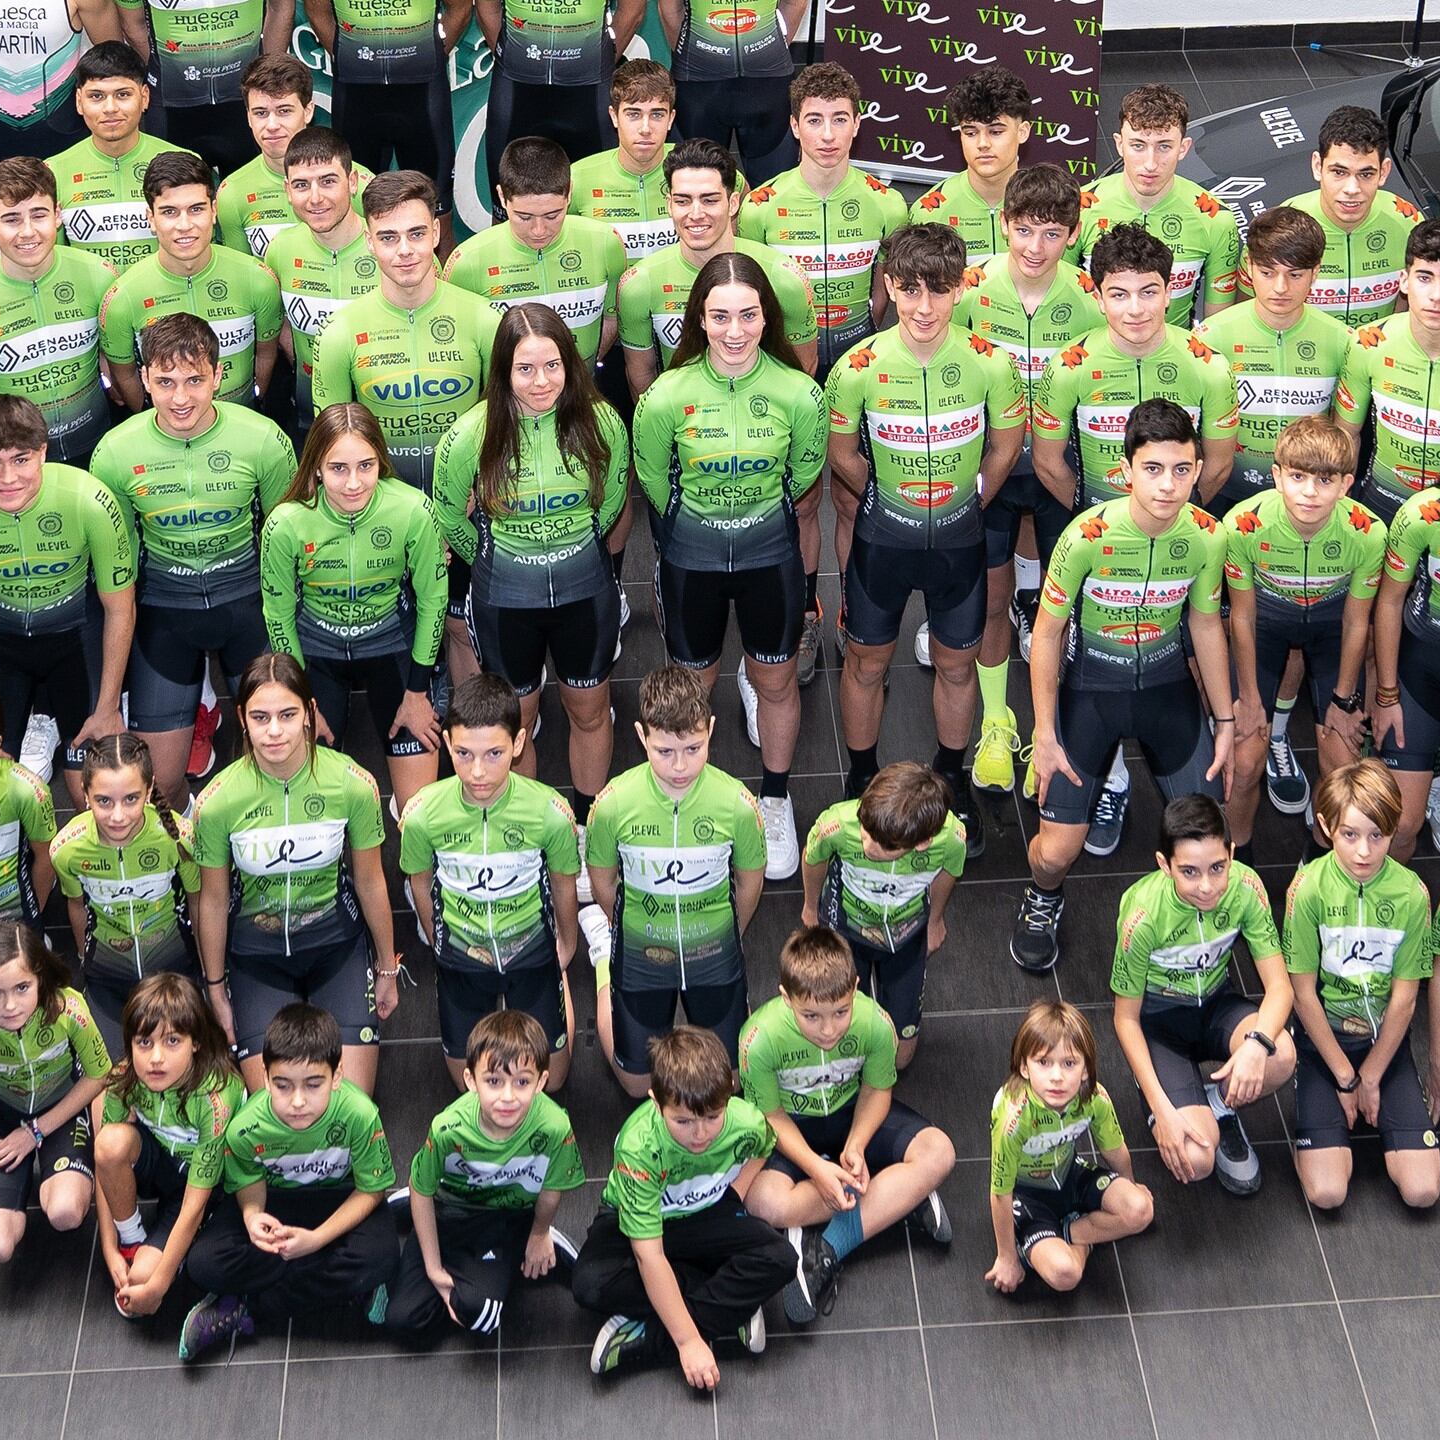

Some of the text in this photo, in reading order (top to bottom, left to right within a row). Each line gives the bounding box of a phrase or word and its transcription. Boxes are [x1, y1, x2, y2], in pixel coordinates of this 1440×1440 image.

[174, 8, 240, 26] Huesca
[976, 4, 1047, 36] vive
[834, 23, 1094, 76] vive vive vive
[878, 63, 947, 94] vive
[1259, 106, 1306, 150] ULEVEL
[876, 133, 945, 162] vive
[26, 328, 94, 357] RENAULT
[428, 350, 465, 363] ULEVEL
[372, 373, 462, 401] vulco
[1274, 387, 1324, 400] RENAULT
[376, 410, 459, 429] Huesca
[887, 427, 974, 444] SUPERMERCADOS
[698, 455, 770, 476] vulco
[889, 451, 963, 469] Huesca
[697, 484, 763, 499] Huesca
[154, 509, 232, 527] vulco
[504, 516, 575, 536] Huesca
[700, 515, 765, 531] AUTOGOYA
[159, 533, 230, 550] Huesca
[513, 543, 583, 567] AUTOGOYA
